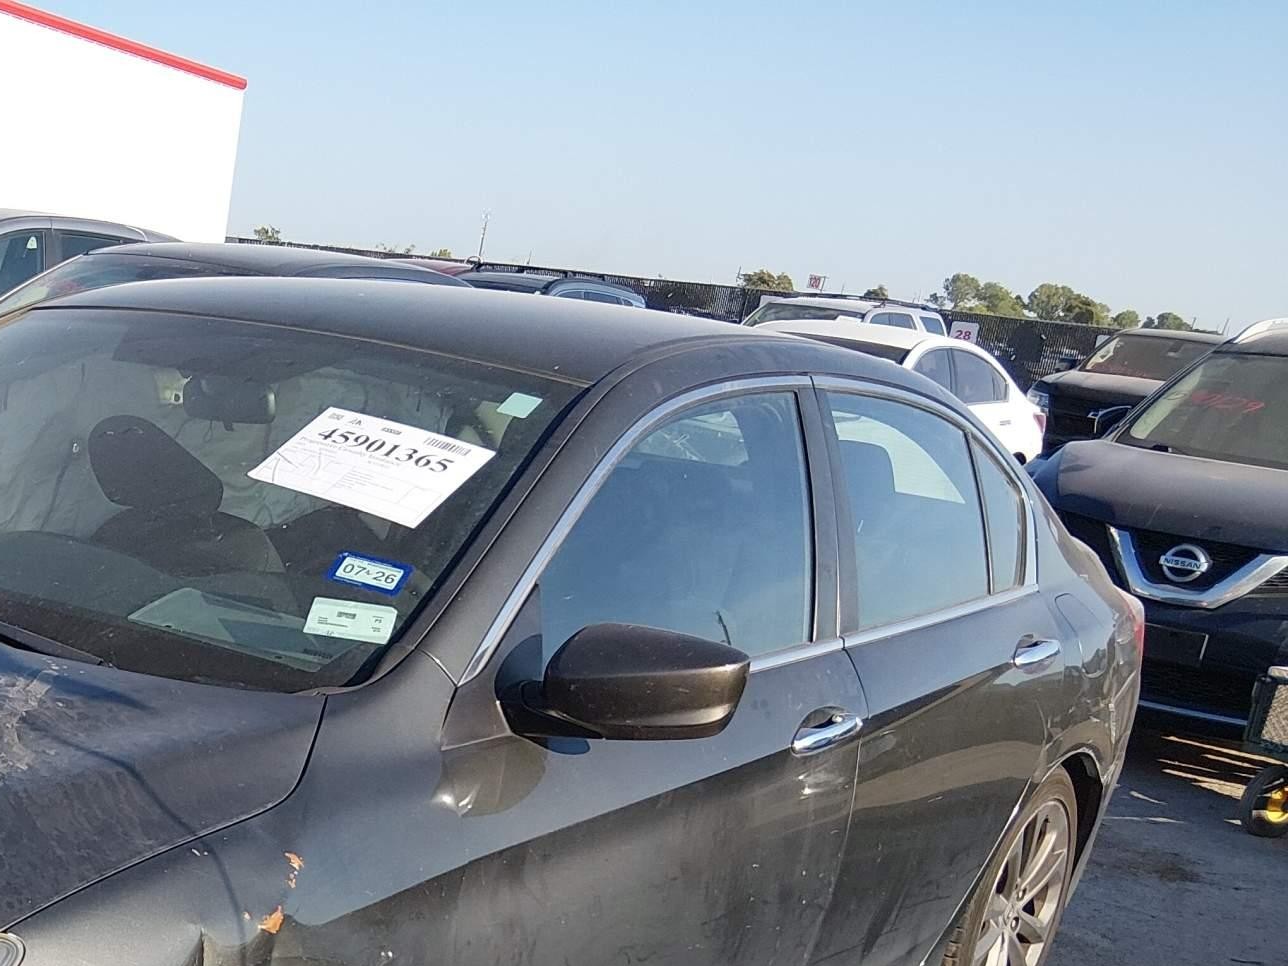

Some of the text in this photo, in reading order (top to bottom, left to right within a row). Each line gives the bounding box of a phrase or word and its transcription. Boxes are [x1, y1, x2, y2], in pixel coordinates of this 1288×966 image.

[954, 329, 972, 341] 28
[317, 427, 456, 473] 45901365
[1164, 557, 1202, 570] NISSAN
[342, 563, 367, 577] 07
[372, 570, 398, 585] 26
